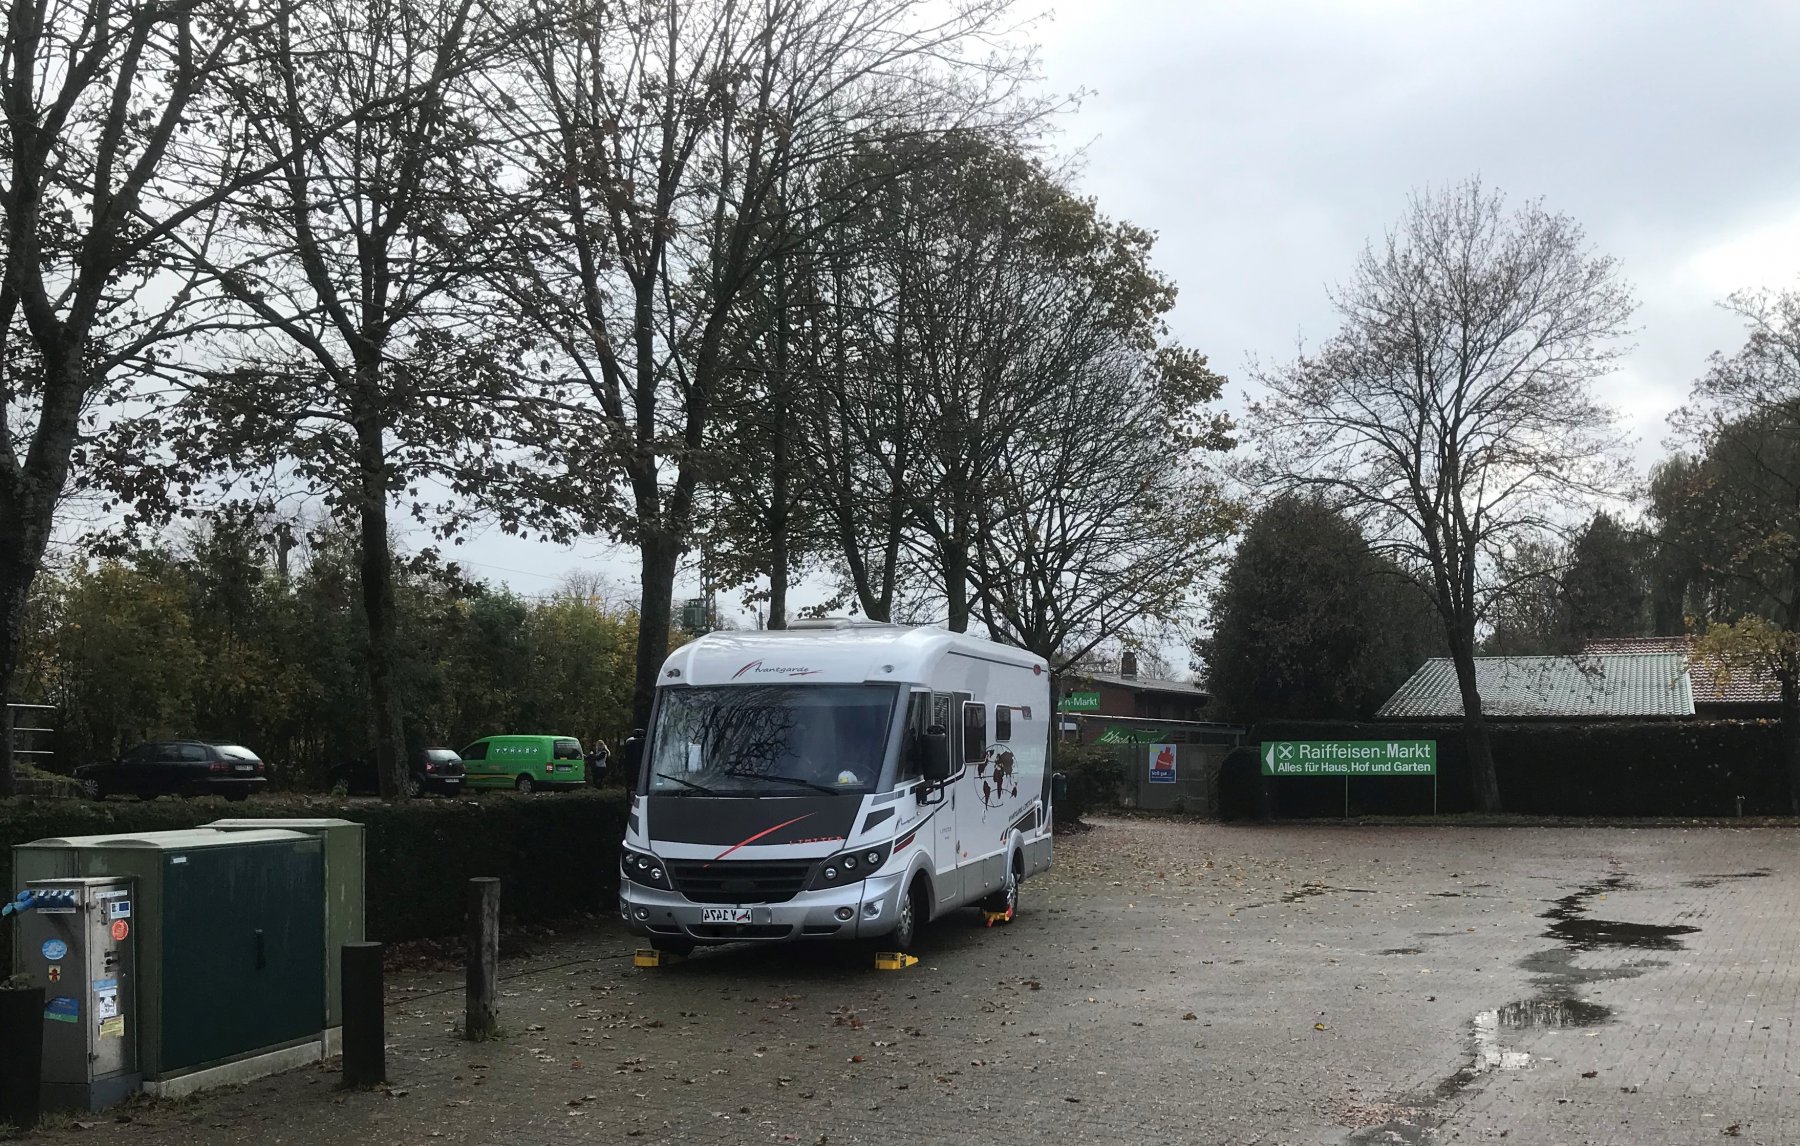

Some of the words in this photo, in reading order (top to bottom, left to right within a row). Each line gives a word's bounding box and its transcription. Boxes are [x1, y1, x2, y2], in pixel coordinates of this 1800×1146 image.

[1299, 743, 1431, 759] Raiffeisen-Markt
[1277, 761, 1303, 772] Alles
[1304, 761, 1320, 772] für
[1371, 762, 1391, 772] und
[1393, 761, 1431, 772] Garten
